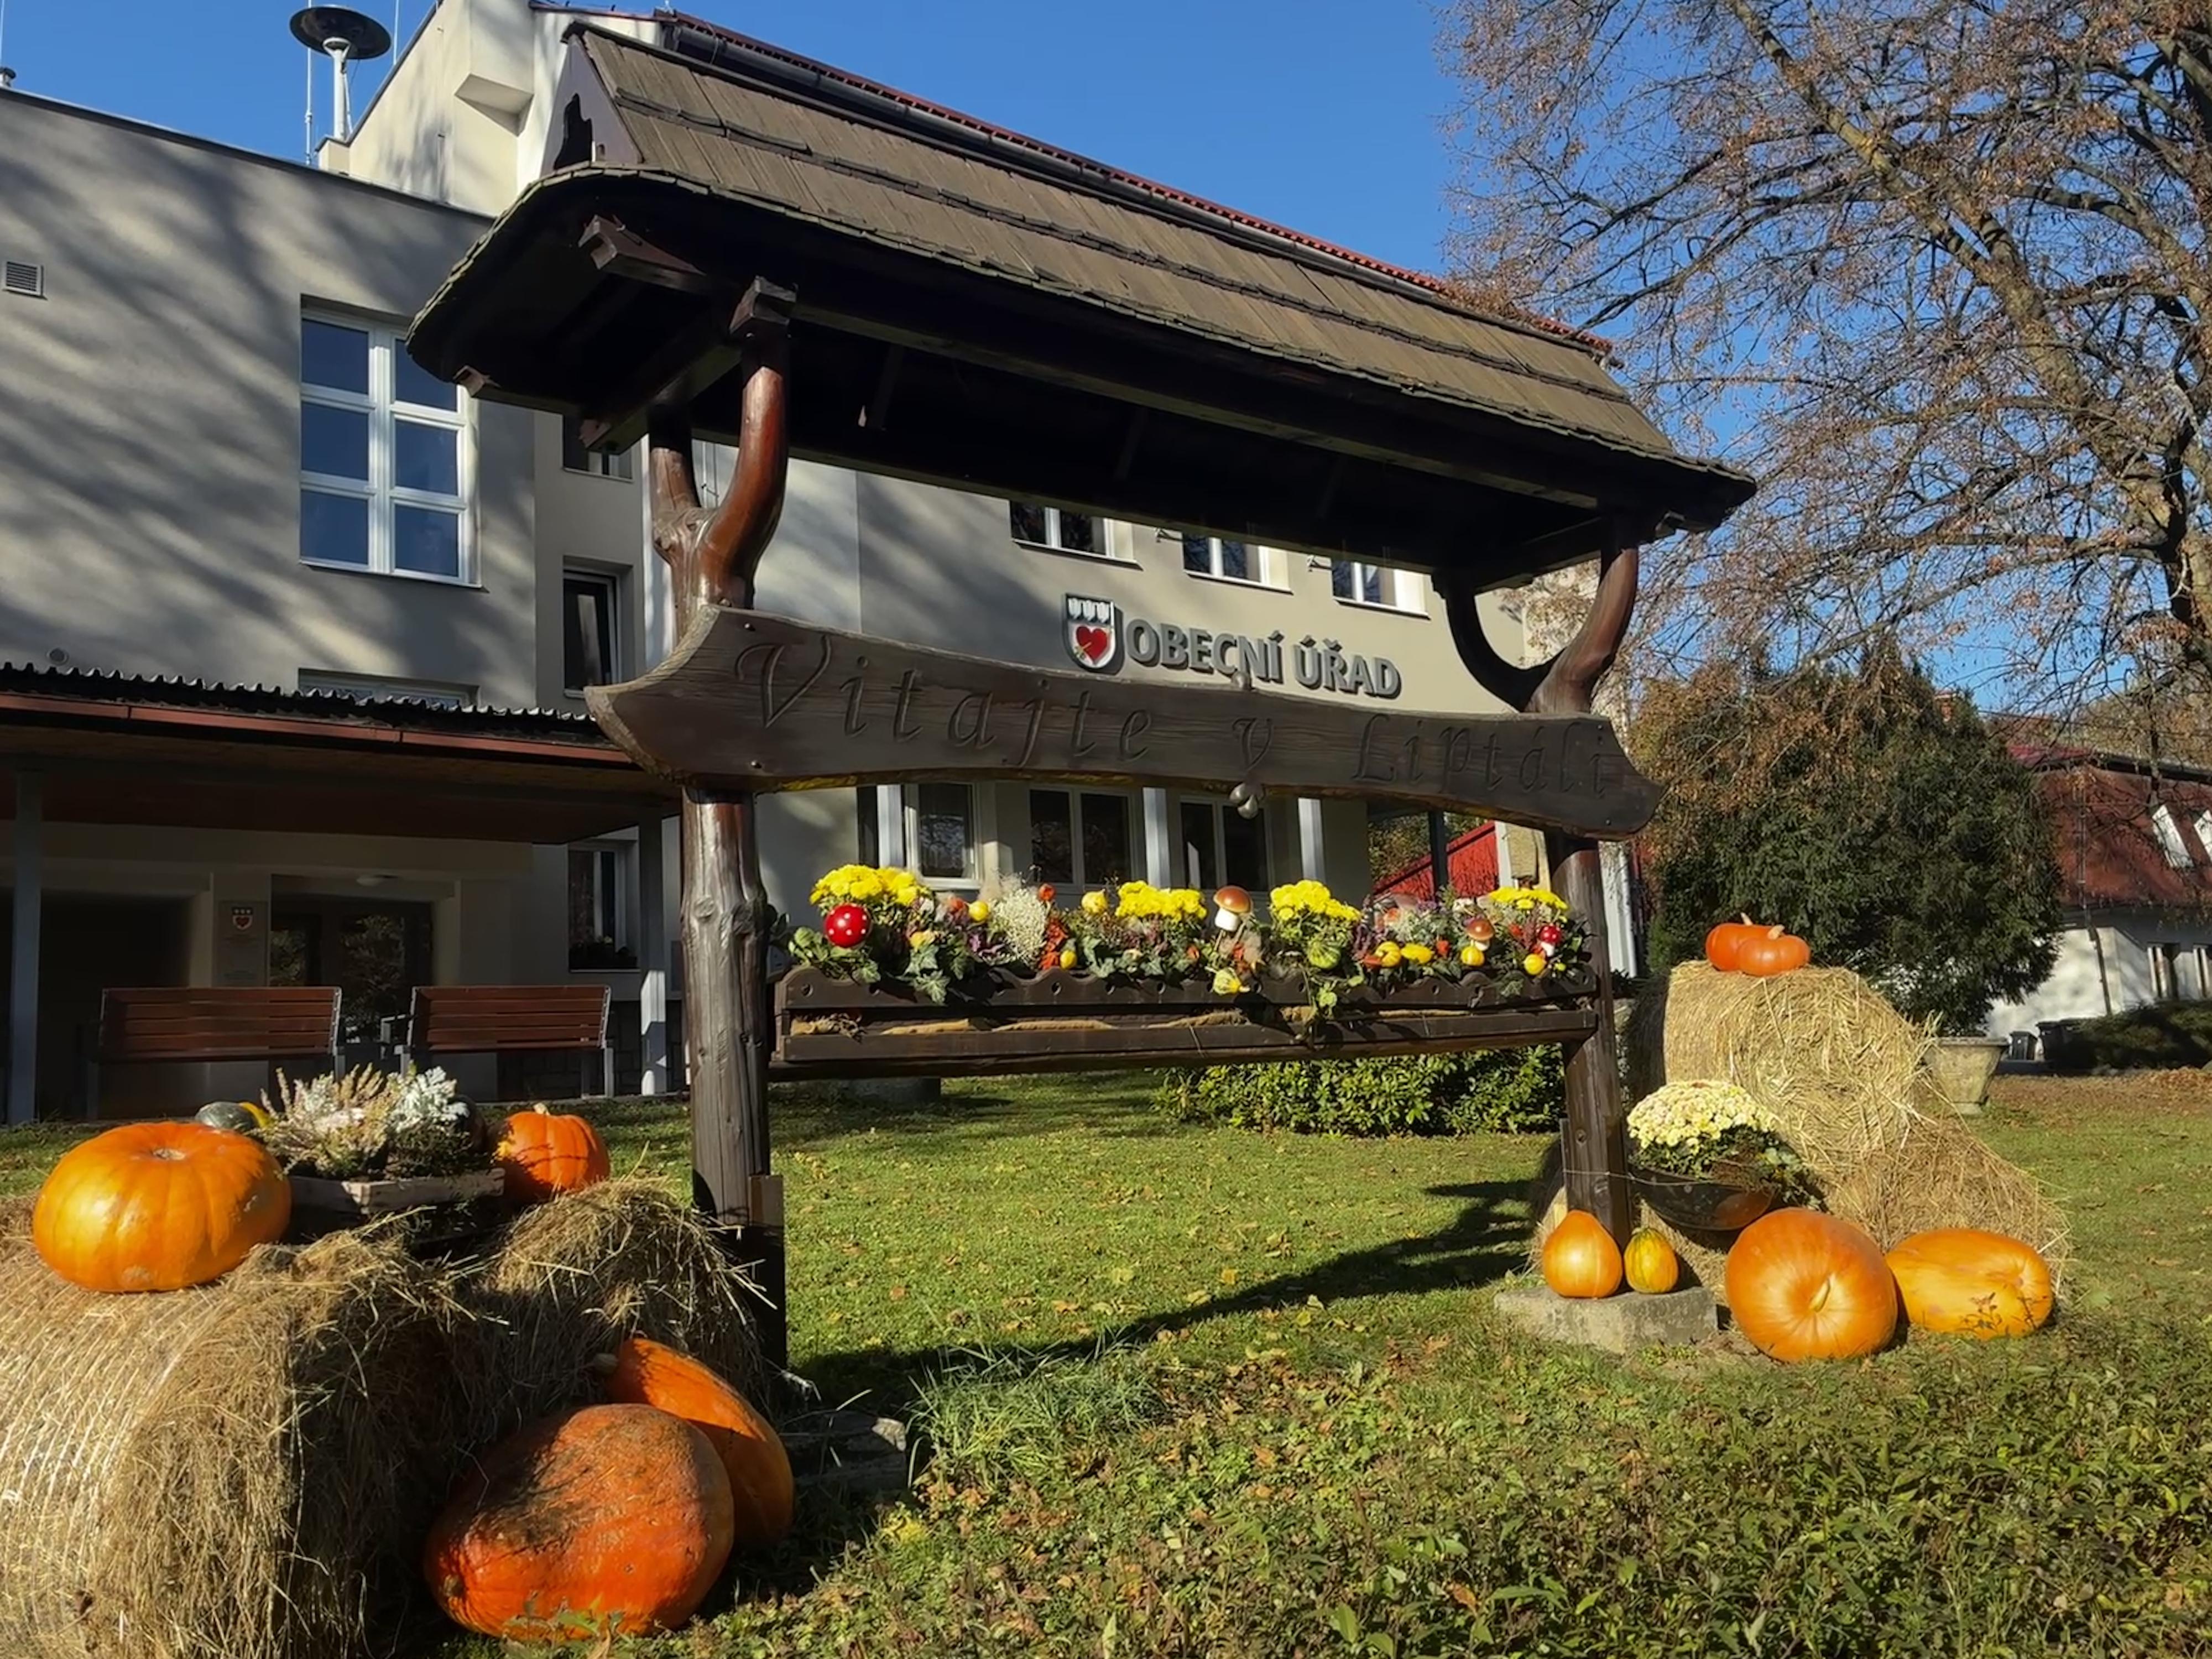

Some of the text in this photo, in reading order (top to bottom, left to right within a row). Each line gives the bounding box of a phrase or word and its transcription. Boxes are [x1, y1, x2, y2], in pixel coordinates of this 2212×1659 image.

[735, 634, 1607, 799] Vitajte v Liptáli
[1126, 619, 1401, 699] OBECNÍ ÚŘAD
